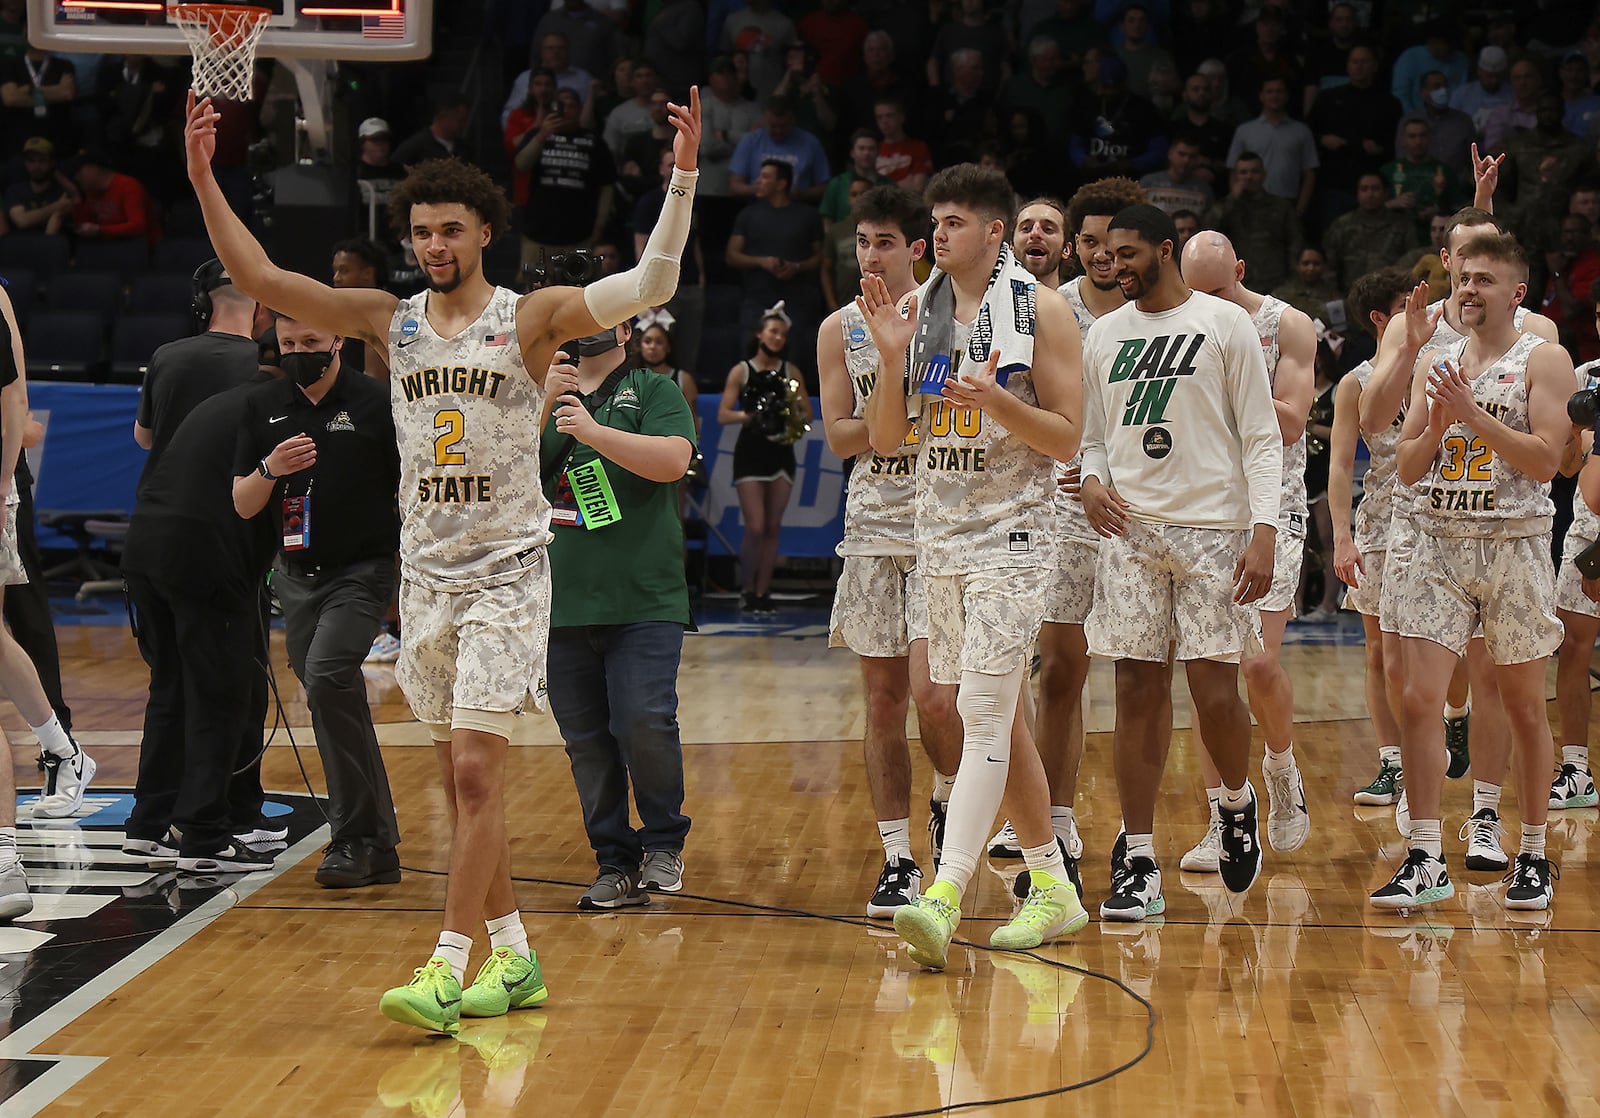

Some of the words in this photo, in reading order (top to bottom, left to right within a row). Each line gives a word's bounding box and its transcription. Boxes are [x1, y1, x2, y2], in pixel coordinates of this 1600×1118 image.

[1089, 137, 1129, 157] Dior
[1017, 294, 1030, 334] MADNESS
[1108, 333, 1206, 384] BALL
[400, 366, 507, 403] WRIGHT
[1121, 377, 1174, 426] IN
[433, 408, 466, 467] 2
[870, 454, 919, 476] STAT
[926, 446, 986, 473] STATE
[1440, 435, 1493, 482] 32
[417, 475, 492, 503] STATE
[572, 464, 615, 524] CONTENT
[1430, 487, 1497, 512] STATE
